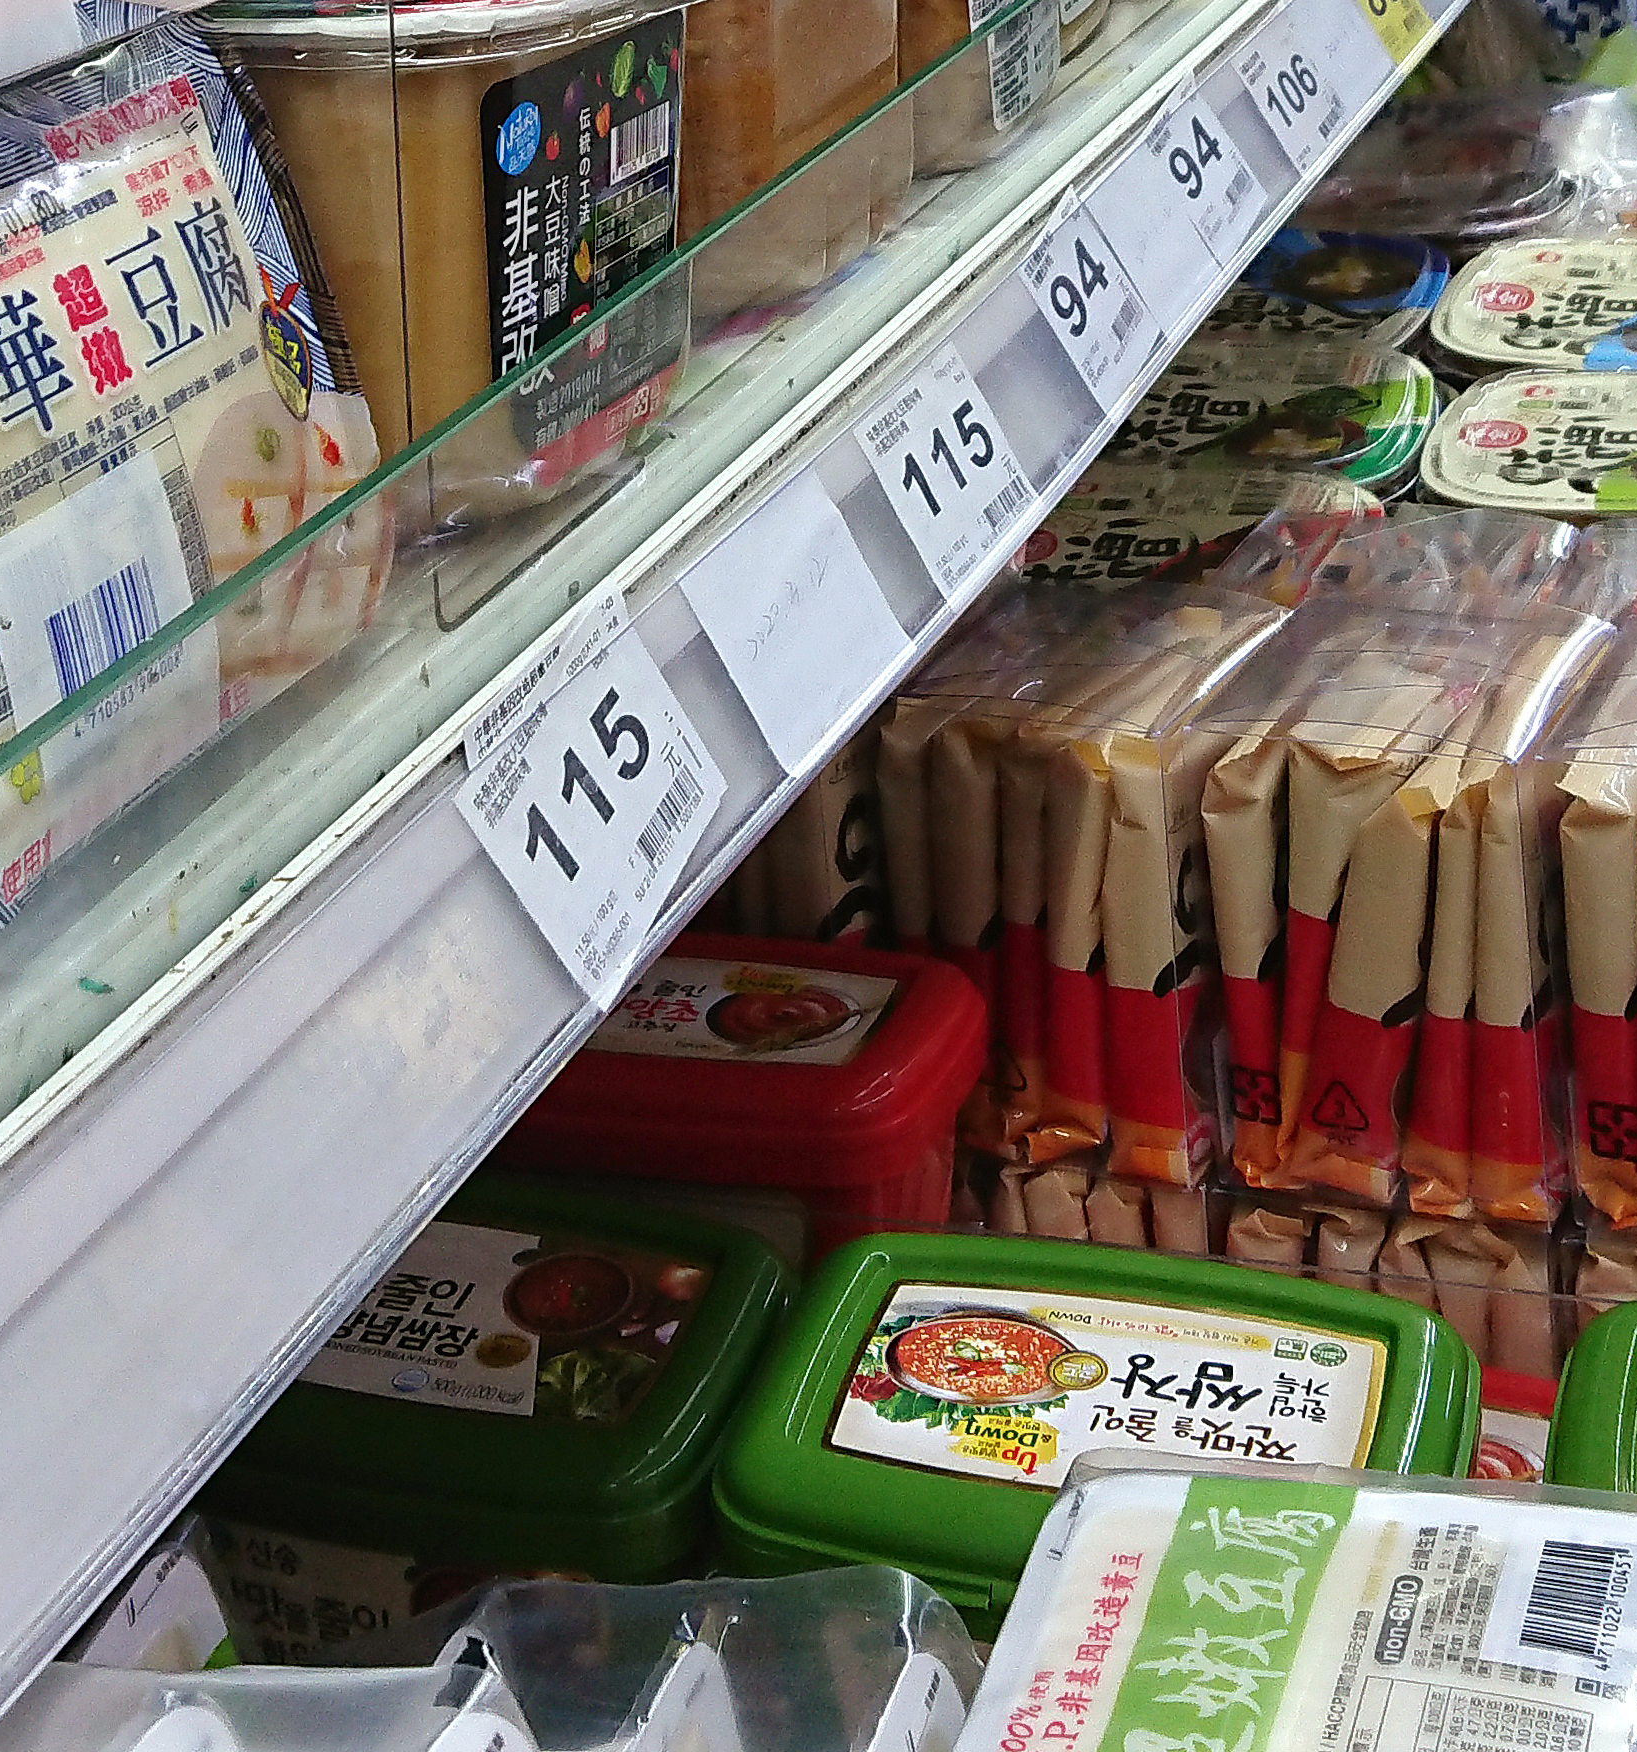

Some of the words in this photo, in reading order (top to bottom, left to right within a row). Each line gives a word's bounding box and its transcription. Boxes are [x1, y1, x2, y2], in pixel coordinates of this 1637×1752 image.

[1265, 53, 1319, 128] 106
[1169, 116, 1223, 200] 94
[543, 174, 563, 317] 大豆味噌
[51, 262, 134, 395] 超嫩
[105, 196, 252, 368] 豆腐
[502, 185, 556, 396] 非基改
[1050, 237, 1109, 338] 94
[901, 399, 995, 518] 115
[1001, 453, 1020, 480] 元
[661, 737, 684, 778] 元
[525, 686, 651, 883] 115
[1110, 1353, 1262, 1413] 쌈장
[1271, 1372, 1330, 1398] 가득
[963, 1416, 1041, 1448] Down
[1090, 1404, 1159, 1444] 줄인
[1268, 1396, 1329, 1424] 한입
[1002, 1446, 1038, 1472] Up
[1171, 1415, 1297, 1462] 짠맛을
[1612, 1551, 1634, 1601] 100451
[1377, 1576, 1421, 1665] non-GMO
[1601, 1606, 1623, 1659] 711022
[1595, 1662, 1609, 1673] 4
